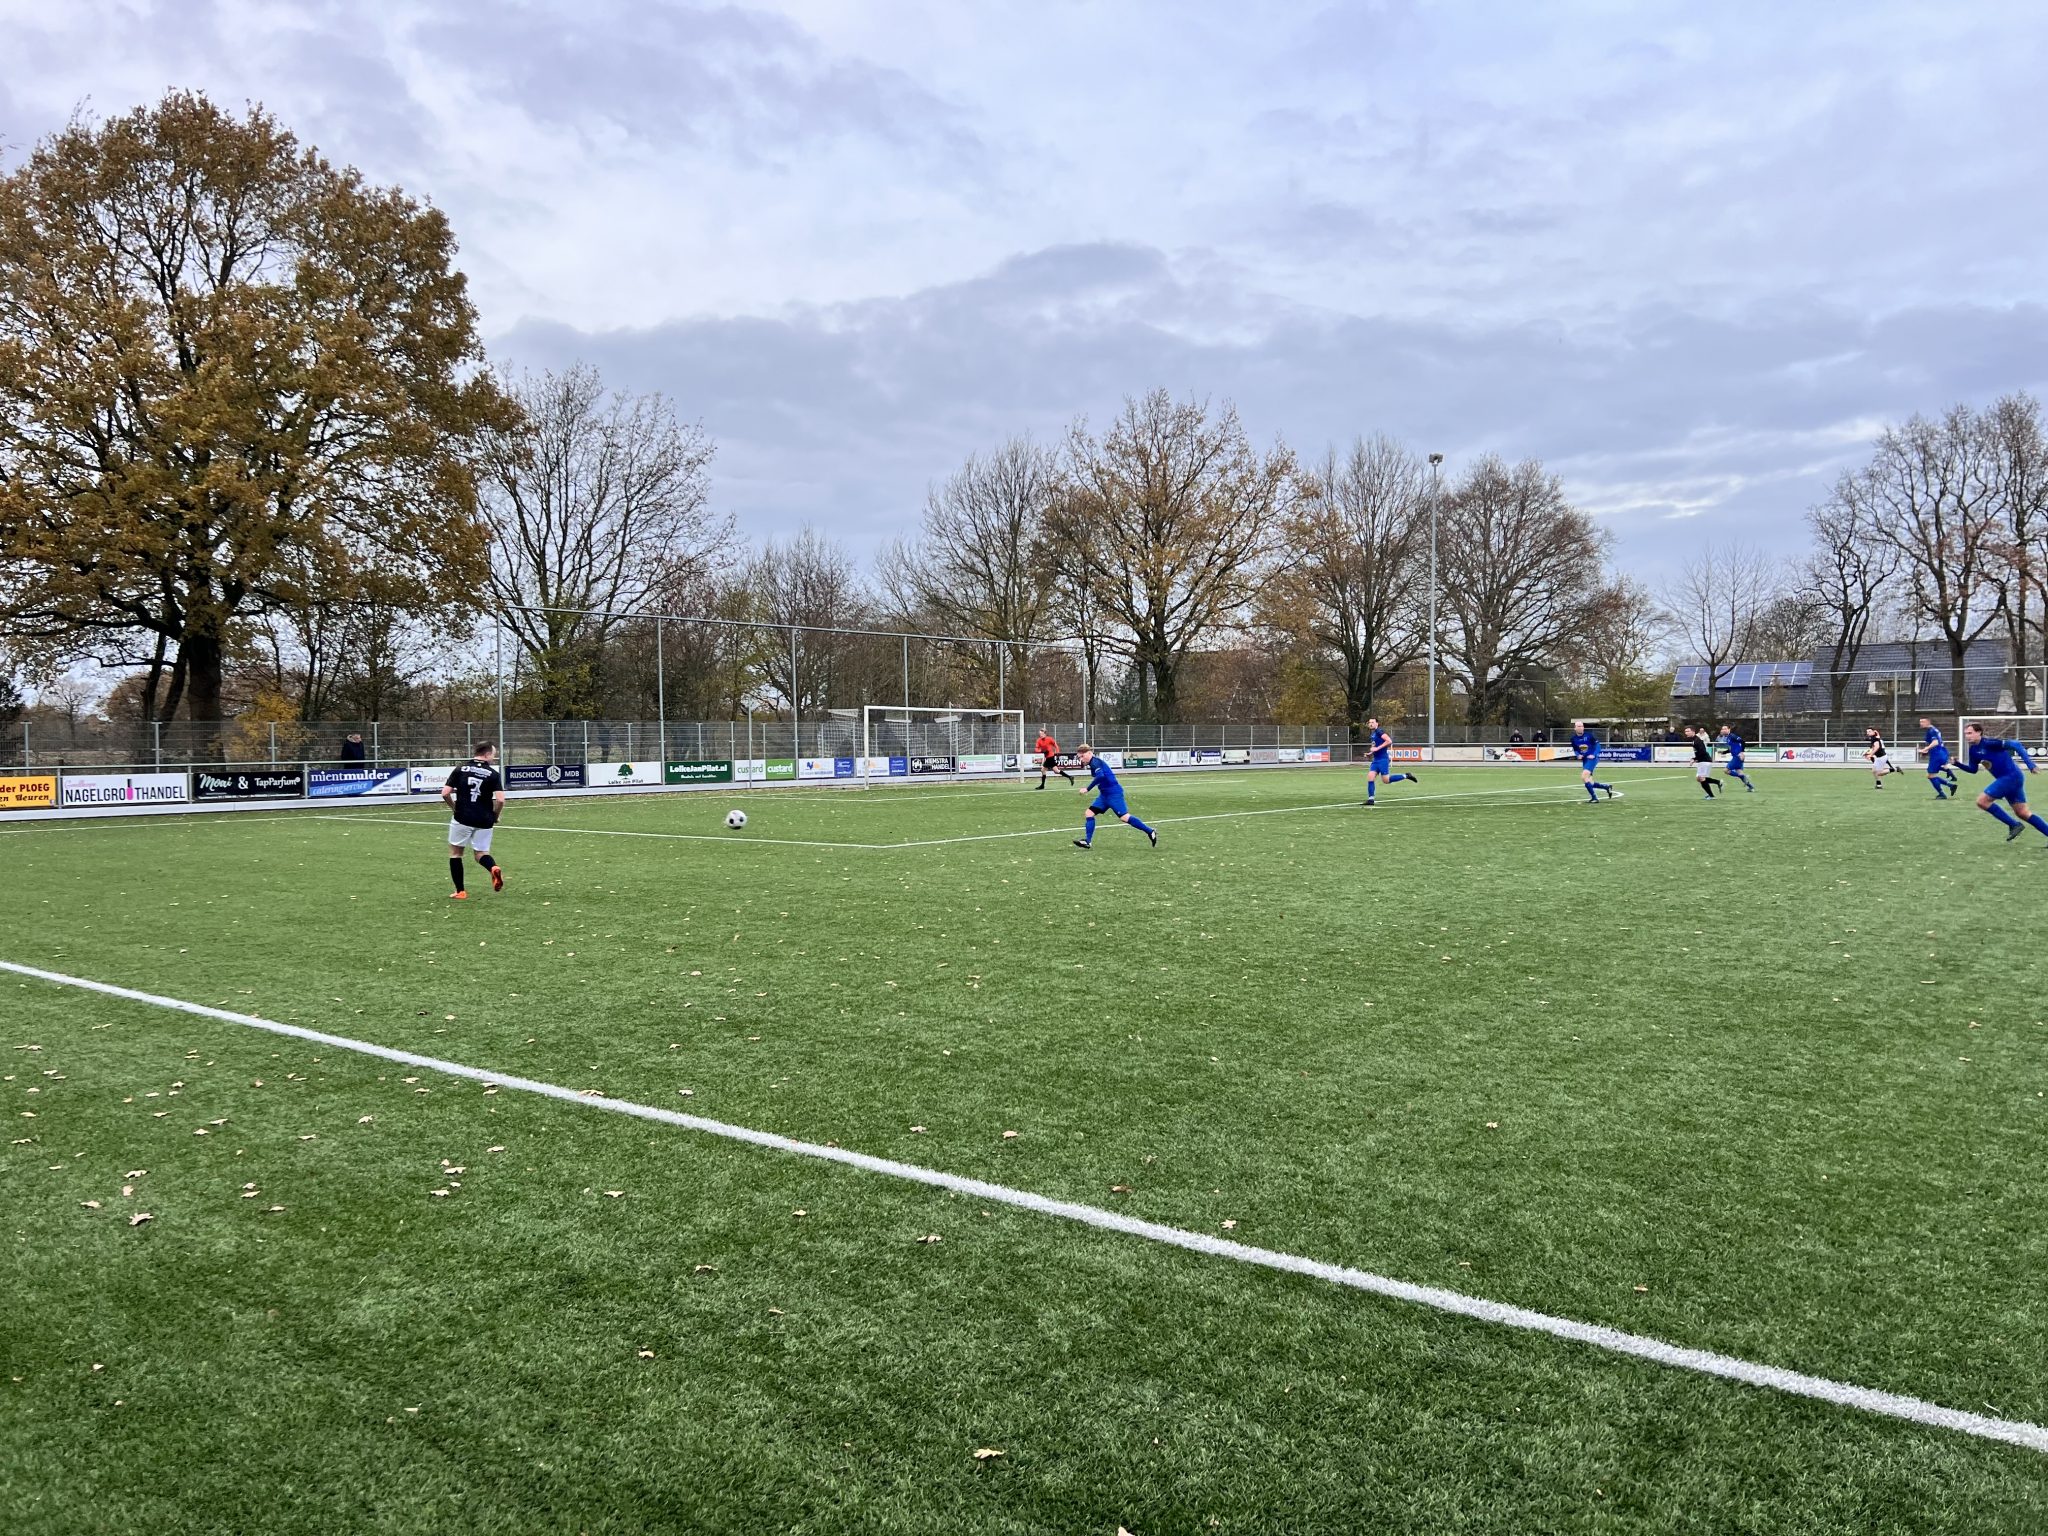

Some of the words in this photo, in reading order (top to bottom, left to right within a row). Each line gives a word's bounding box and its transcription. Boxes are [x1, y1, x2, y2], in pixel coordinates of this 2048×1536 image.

[737, 764, 763, 773] cusard
[767, 763, 793, 773] custard
[311, 769, 391, 782] mientmulder
[19, 783, 50, 792] PLOEG
[238, 776, 249, 790] &
